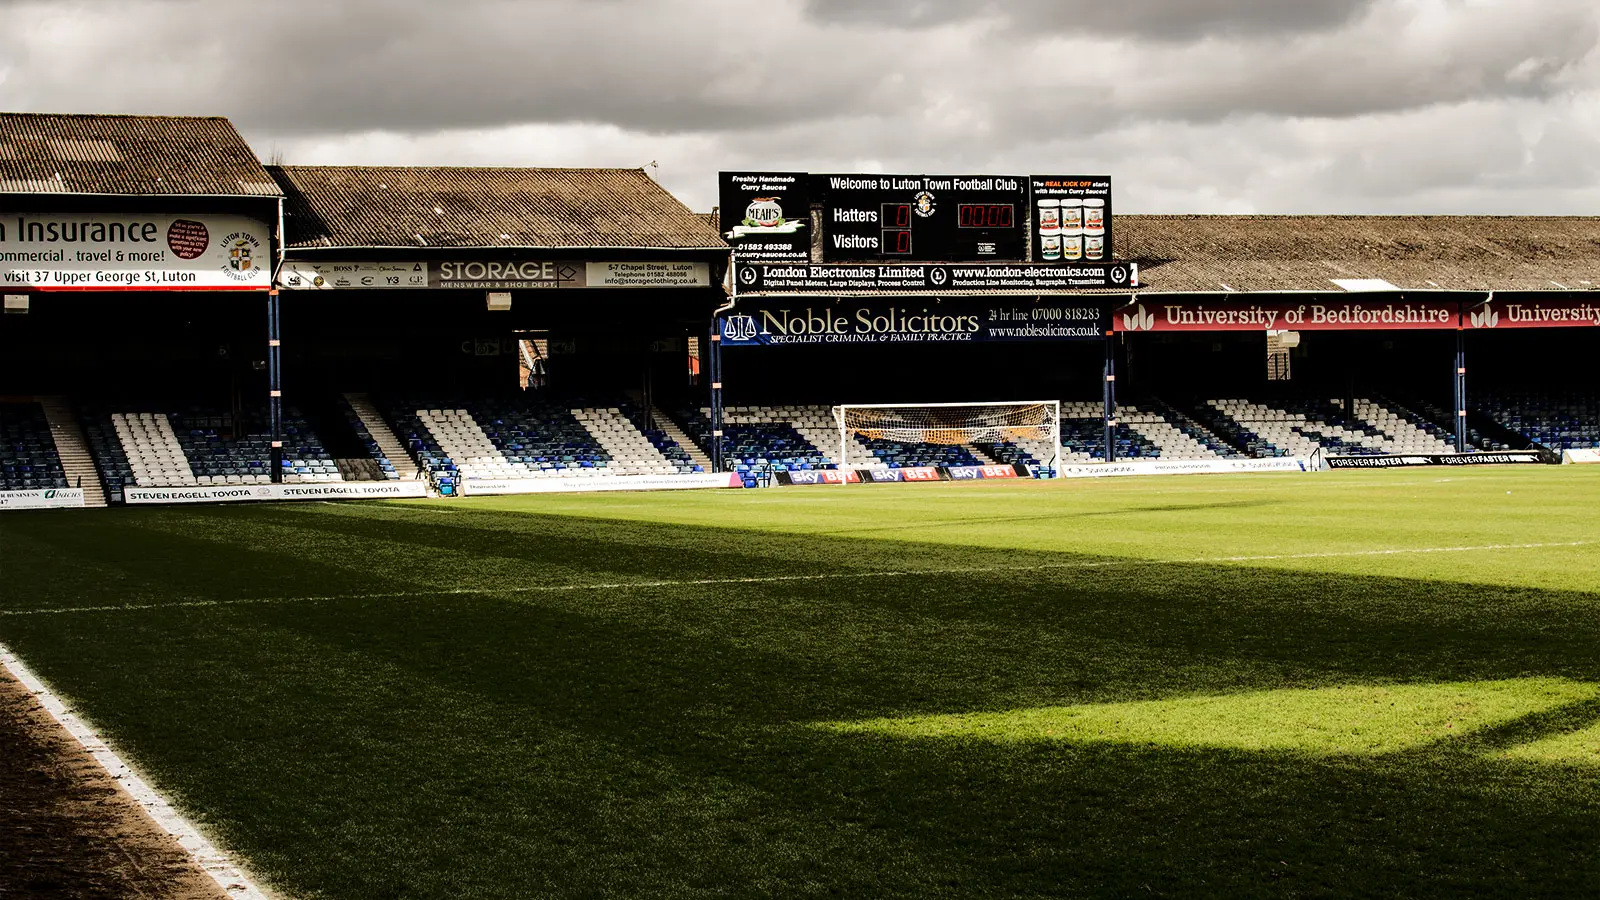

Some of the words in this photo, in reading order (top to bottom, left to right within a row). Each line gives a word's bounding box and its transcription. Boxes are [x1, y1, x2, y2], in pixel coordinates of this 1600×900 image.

[830, 177, 877, 190] Welcome
[880, 178, 890, 190] to
[892, 178, 921, 190] Luton
[923, 178, 951, 190] Town
[953, 178, 993, 191] Football
[995, 179, 1018, 191] Club
[748, 208, 779, 220] MEAH'S
[833, 208, 878, 222] Hatters
[18, 217, 158, 242] Insurance
[221, 232, 240, 248] LUTON
[242, 232, 260, 248] TOWN
[832, 234, 878, 249] Visitors
[76, 250, 111, 262] travel
[116, 250, 125, 262] &
[128, 250, 165, 262] more!
[221, 265, 247, 281] FOOTBALL
[248, 265, 261, 279] CLUB
[440, 262, 554, 280] STORAGE
[763, 266, 807, 278] London
[810, 266, 876, 278] Electronics
[878, 266, 925, 278] Limited
[952, 266, 1105, 278] www.london-electronics.com
[4, 271, 30, 283] visit
[34, 271, 49, 282] 37
[54, 271, 91, 284] Upper
[95, 271, 141, 285] George
[763, 279, 785, 287] Digital
[786, 279, 804, 287] Panel
[805, 279, 829, 287] Meters,
[829, 279, 847, 288] Large
[848, 279, 877, 288] Displays,
[877, 279, 901, 287] Process
[902, 279, 925, 287] Control
[952, 279, 985, 287] Production
[986, 279, 999, 287] Line
[1000, 279, 1035, 287] Monitoring,
[1035, 279, 1067, 287] Bargraphs,
[1068, 278, 1105, 286] Transmitters
[759, 307, 849, 335] Noble
[855, 307, 980, 334] Solicitors
[988, 309, 998, 322] 24
[1000, 308, 1011, 321] hr
[1012, 308, 1029, 321] line
[1032, 308, 1062, 321] 07000
[1064, 308, 1100, 321] 818283
[1164, 305, 1278, 329] University
[1284, 305, 1306, 324] of
[1310, 304, 1449, 324] Bedfordshire
[988, 323, 1100, 337] www.noblesolicitors.co.uk
[769, 334, 825, 344] SPECIALIST
[825, 334, 877, 343] CRIMINAL
[879, 333, 888, 342] &
[890, 333, 926, 342] FAMILY
[926, 332, 972, 341] PRACTICE
[792, 472, 819, 484] sky
[873, 469, 902, 481] sky
[905, 468, 933, 479] BET
[952, 467, 978, 479] sky
[984, 466, 1011, 477] BET
[44, 490, 81, 499] abacus
[130, 492, 170, 500] STEVEN
[172, 491, 211, 499] EAGELL
[211, 489, 251, 497] TOYOTA
[283, 487, 323, 496] STEVEN
[323, 486, 360, 495] EAGELL
